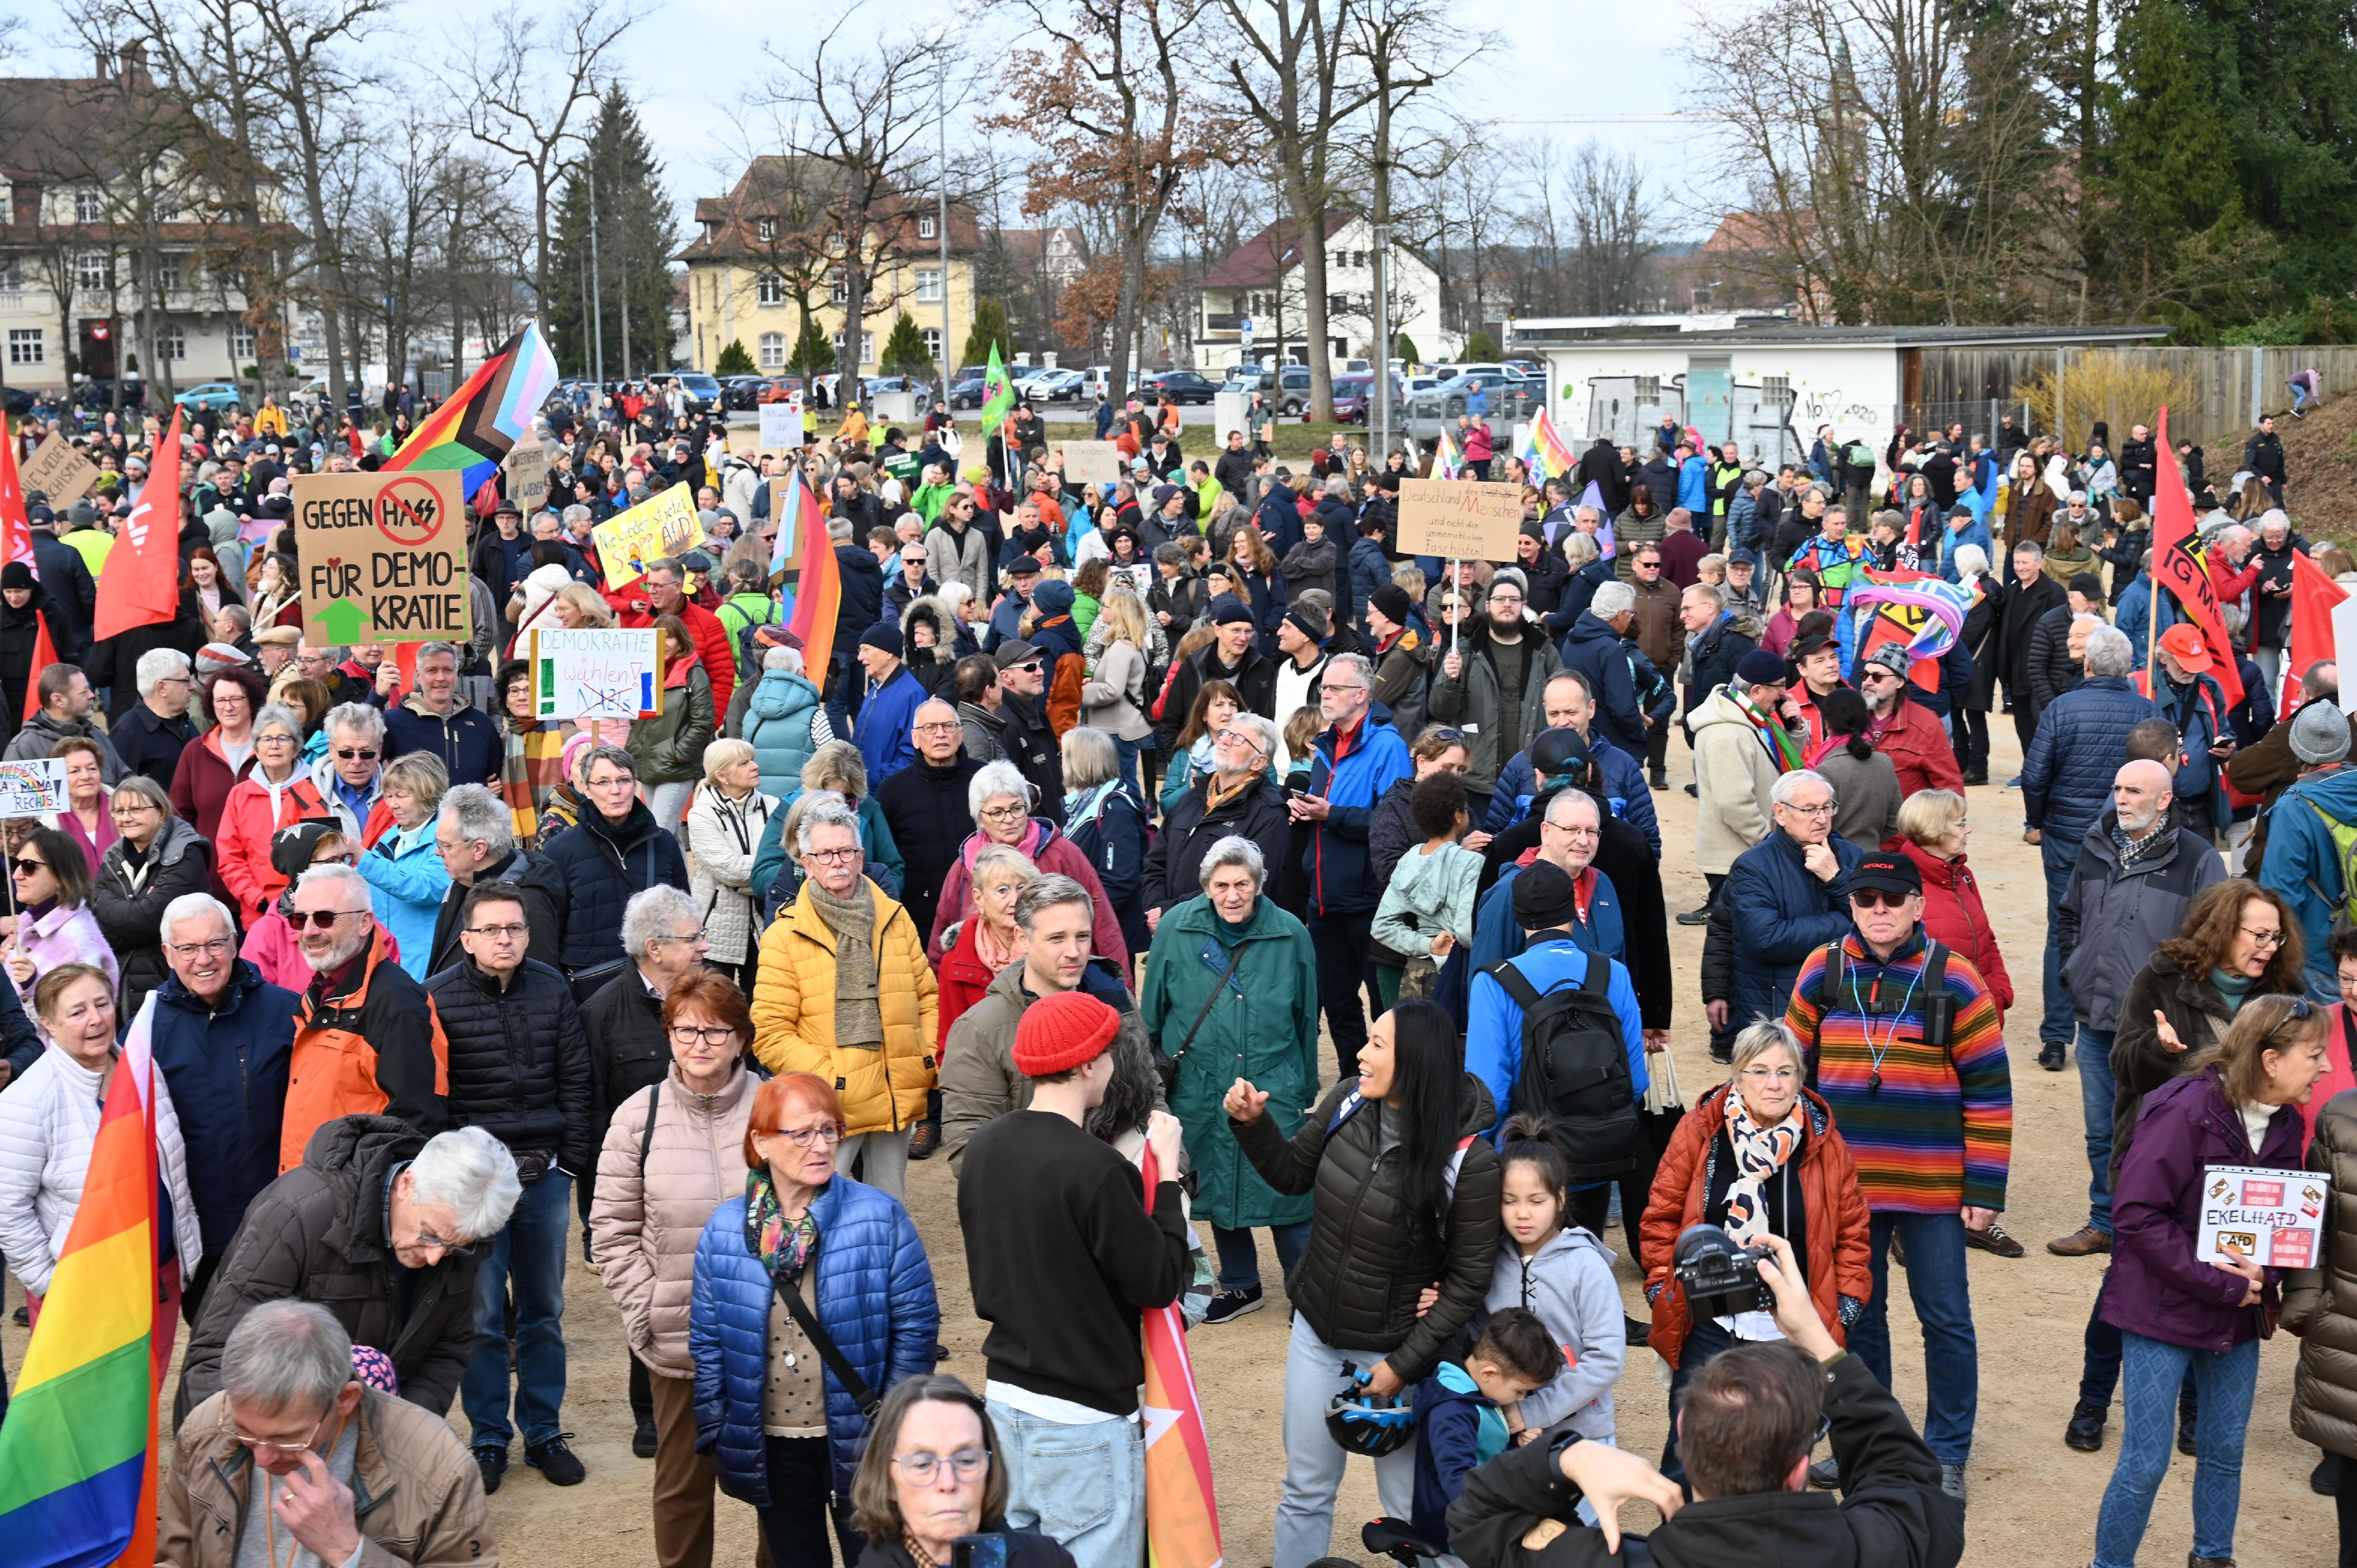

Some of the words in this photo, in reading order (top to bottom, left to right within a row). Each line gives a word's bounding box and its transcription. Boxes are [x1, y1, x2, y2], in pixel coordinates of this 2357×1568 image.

[20, 472, 42, 495] NIE
[36, 440, 70, 477] WIEDER
[45, 453, 87, 503] SCHISMUS
[652, 506, 662, 524] ist
[662, 493, 687, 525] jetzt
[1403, 486, 1461, 505] Deutschland
[1465, 484, 1478, 495] den
[1459, 495, 1519, 518] Menschen
[303, 499, 372, 529] GEGEN
[1428, 517, 1445, 526] und
[1446, 519, 1464, 527] nicht
[1466, 520, 1478, 529] den
[1425, 539, 1484, 557] Faschisten!
[1426, 530, 1484, 542] unmenschlichen
[612, 533, 653, 573] STOPP
[2163, 548, 2193, 585] IG
[372, 552, 466, 588] DEMO-
[372, 594, 463, 631] KRATIE
[541, 631, 652, 652] DEMOKRATIE
[564, 658, 642, 687] wählen!
[2207, 1209, 2298, 1226] EKELHAFD
[2227, 1232, 2252, 1246] AfD
